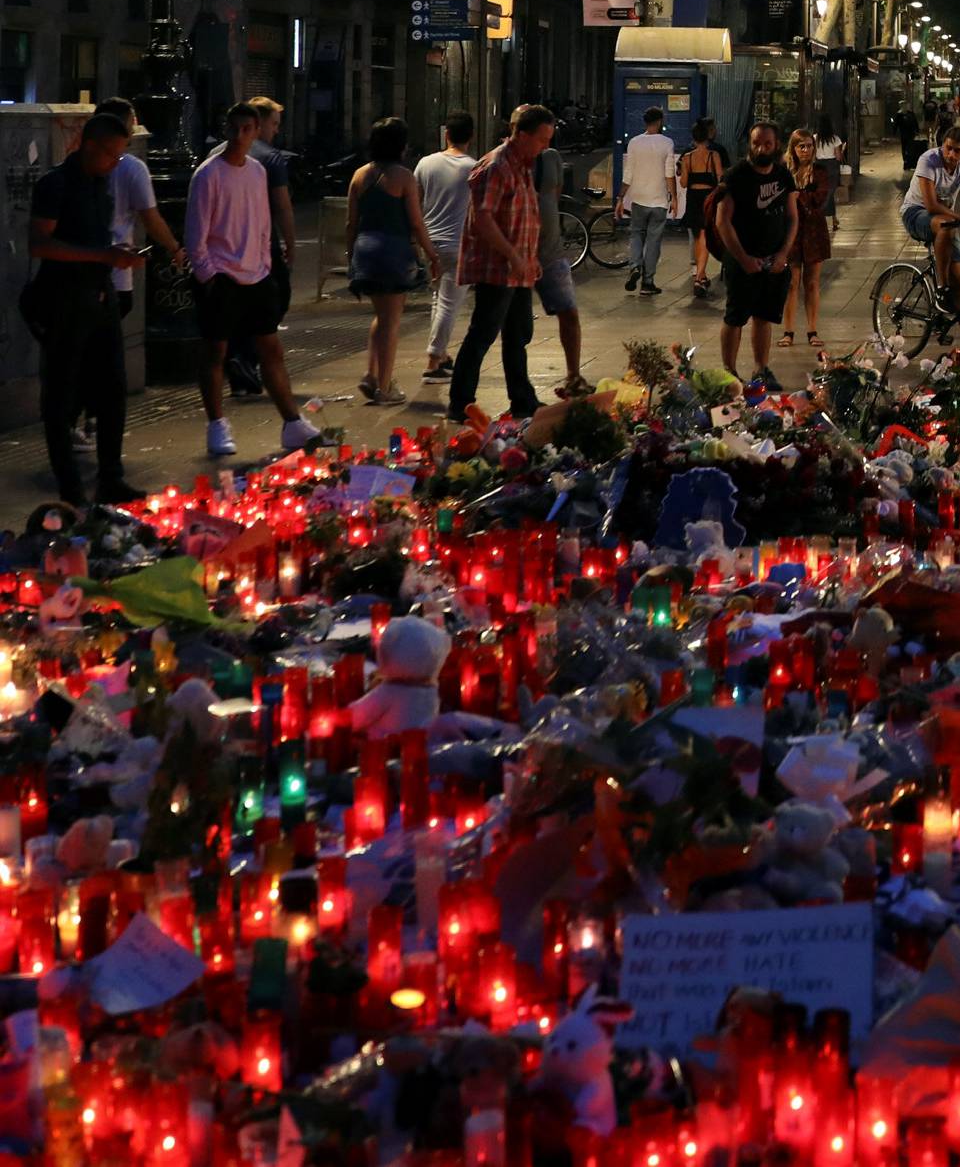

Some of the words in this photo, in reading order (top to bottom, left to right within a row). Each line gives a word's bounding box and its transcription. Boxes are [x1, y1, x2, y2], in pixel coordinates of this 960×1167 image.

[759, 181, 780, 200] NIKE
[632, 929, 671, 951] NO
[675, 927, 735, 950] MORE
[629, 958, 662, 977] NO
[668, 954, 727, 975] MORE
[743, 951, 803, 973] HATE
